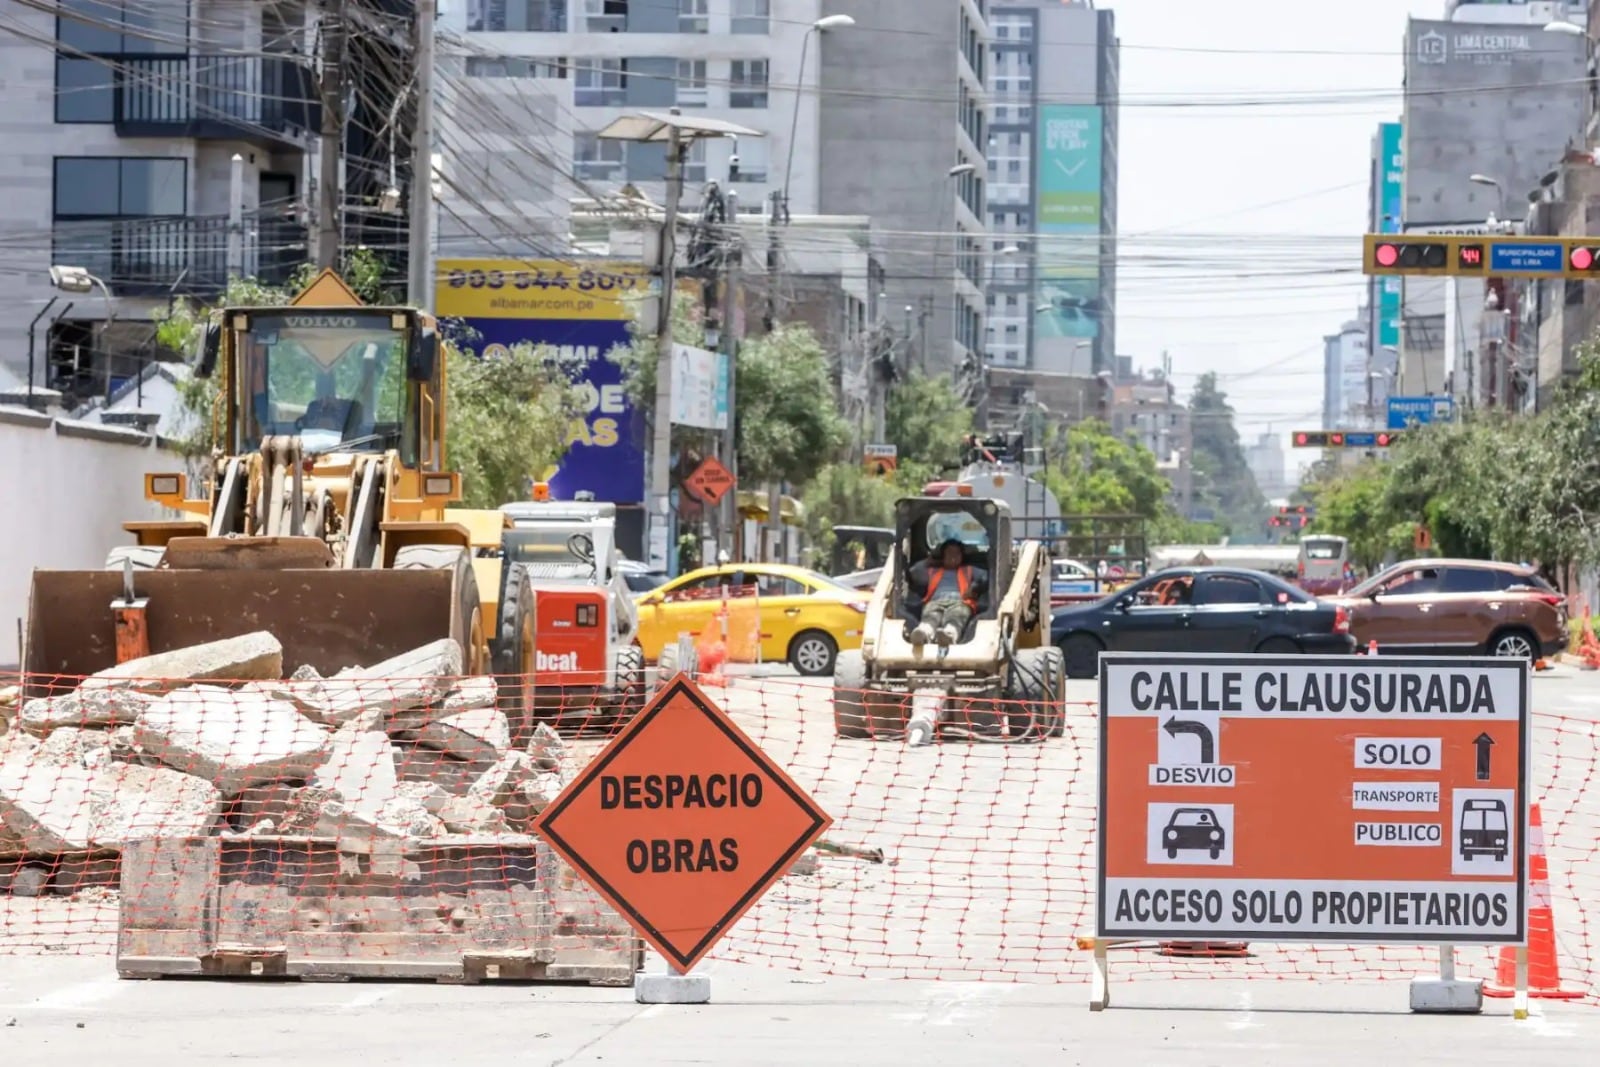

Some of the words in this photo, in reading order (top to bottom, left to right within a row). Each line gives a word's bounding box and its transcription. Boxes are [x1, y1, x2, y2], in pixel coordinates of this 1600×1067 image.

[1454, 35, 1481, 49] LIMA
[1483, 36, 1530, 50] CENTRAL
[1498, 248, 1556, 257] MUNICIPALIDAD
[1524, 258, 1542, 266] LIMA
[284, 316, 357, 328] VOLVO
[536, 650, 577, 671] bcat
[1130, 671, 1242, 711] CALLE
[1254, 672, 1496, 714] CLAUSURADA
[1363, 743, 1432, 766] SOLO
[1156, 766, 1234, 785] DESVIO
[600, 773, 763, 810] DESPACIO
[1354, 789, 1439, 804] TRANSPORTE
[1356, 823, 1441, 842] PUBLICO
[626, 837, 740, 874] OBRAS
[1115, 888, 1224, 923] ACCESO
[1231, 889, 1304, 925] SOLO
[1312, 890, 1508, 927] PROPIETARIOS
